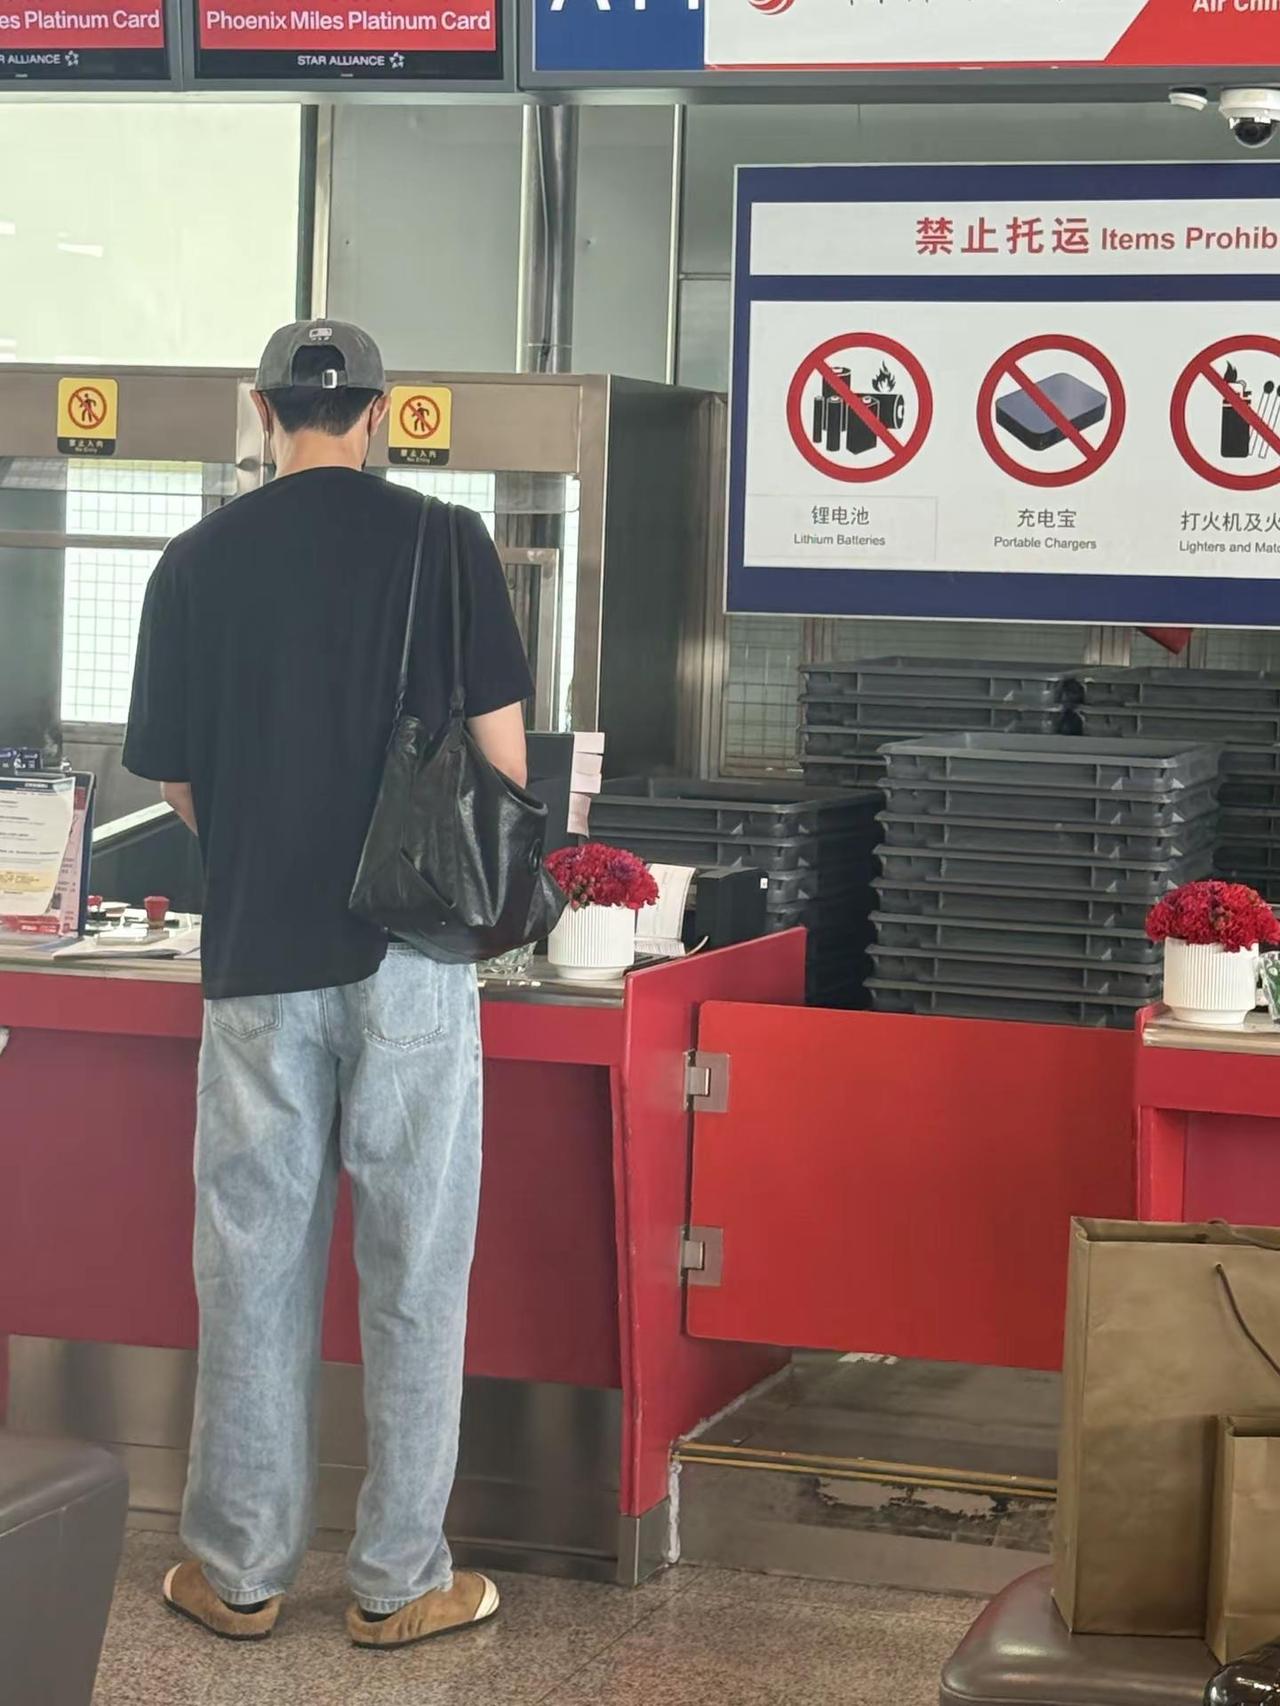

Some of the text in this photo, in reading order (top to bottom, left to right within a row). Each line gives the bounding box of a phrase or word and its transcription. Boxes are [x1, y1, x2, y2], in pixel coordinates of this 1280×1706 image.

[24, 11, 109, 29] Platinum
[113, 10, 160, 28] Card
[206, 11, 490, 30] Phoenix Miles Platinum Card
[8, 54, 61, 64] ALLIANCE
[297, 56, 385, 66] STAR ALLIANCE
[915, 216, 1090, 256] 禁止托运
[1101, 226, 1278, 251] Items Prohib
[811, 505, 870, 526] 锂电池
[1016, 508, 1077, 529] 充电宝
[1180, 510, 1280, 532] 打火机及火
[794, 533, 886, 546] Lithium Batteries
[994, 536, 1097, 550] Portable Chargers
[1179, 540, 1226, 554] Lighters
[1229, 542, 1251, 552] and
